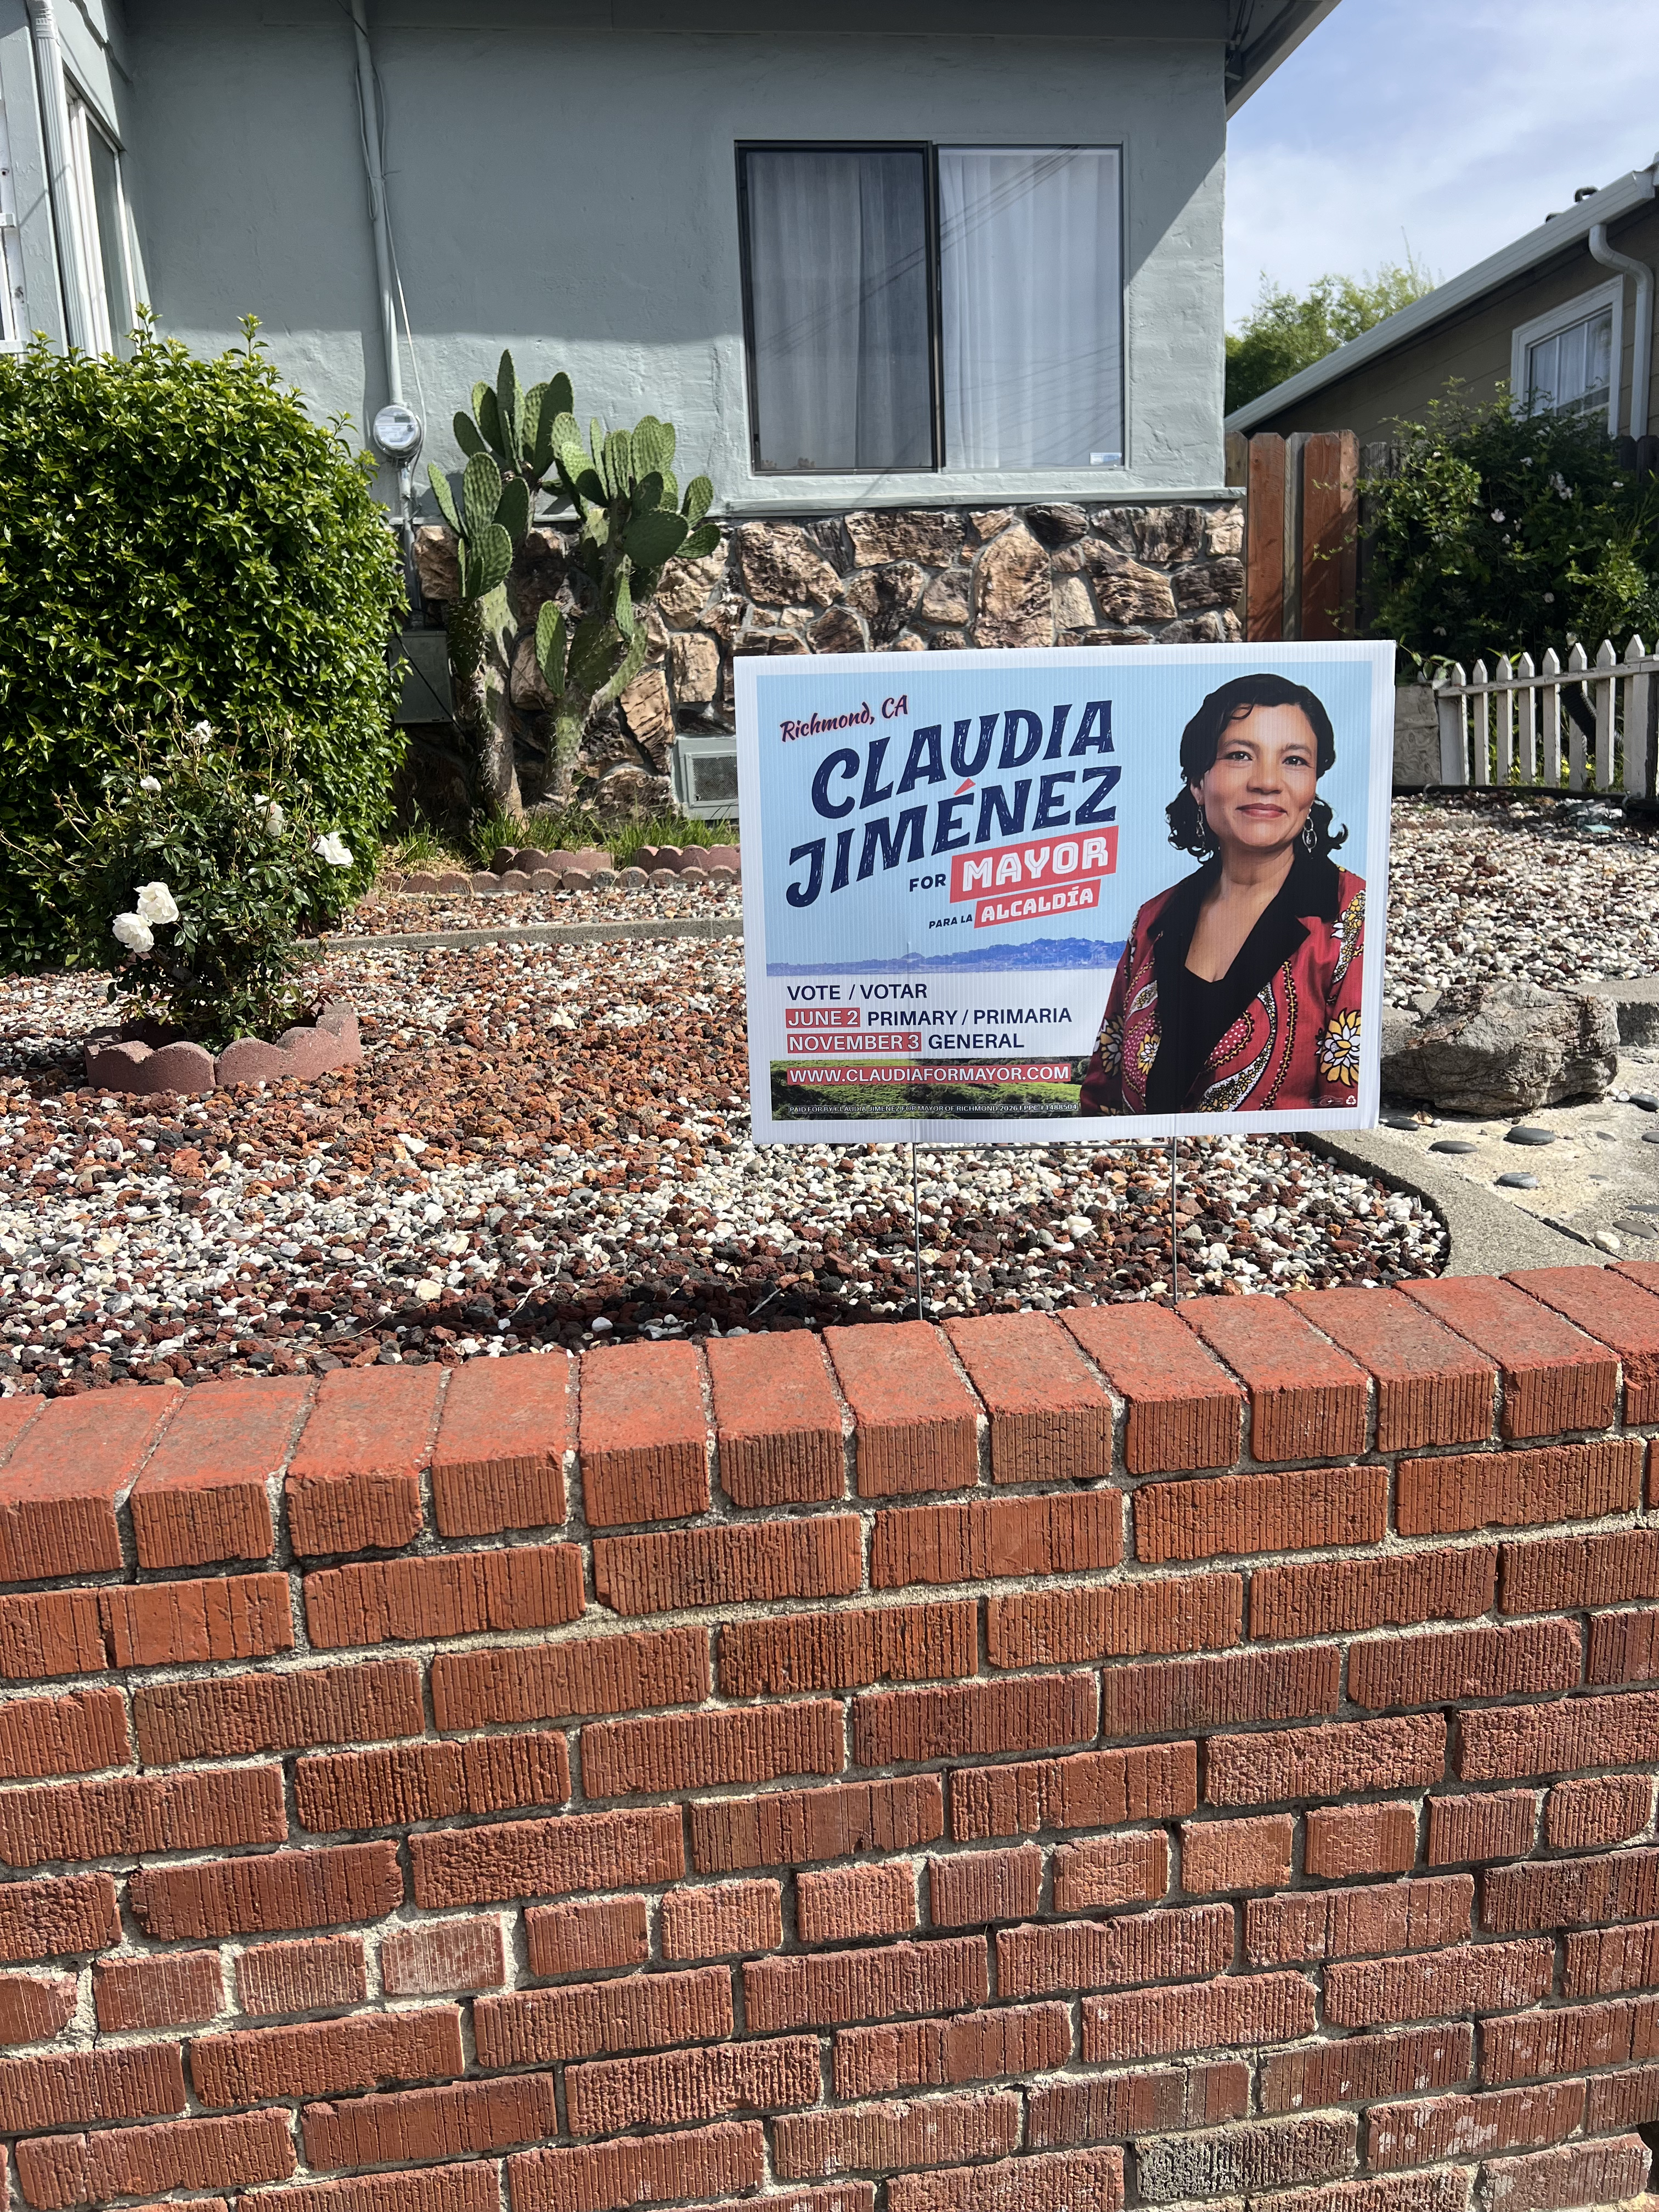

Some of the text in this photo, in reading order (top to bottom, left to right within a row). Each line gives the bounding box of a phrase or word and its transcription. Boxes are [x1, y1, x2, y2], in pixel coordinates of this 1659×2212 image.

[780, 695, 909, 743] Richmond, CA
[811, 699, 1115, 820] CLAUDIA
[786, 765, 1122, 907] JIMÉNEZ
[909, 836, 1108, 893] FOR MAYOR
[928, 887, 1093, 929] PARA LA ALCALDÍA
[787, 983, 927, 1001] VOTE / VOTAR
[788, 1007, 1073, 1027] JUNE 2 PRIMARY / PRIMARIA
[789, 1033, 1024, 1051] NOVEMBER 3 GENERAL
[789, 1065, 1069, 1083] WWW.CLAUDIAFORMAYOR.COM
